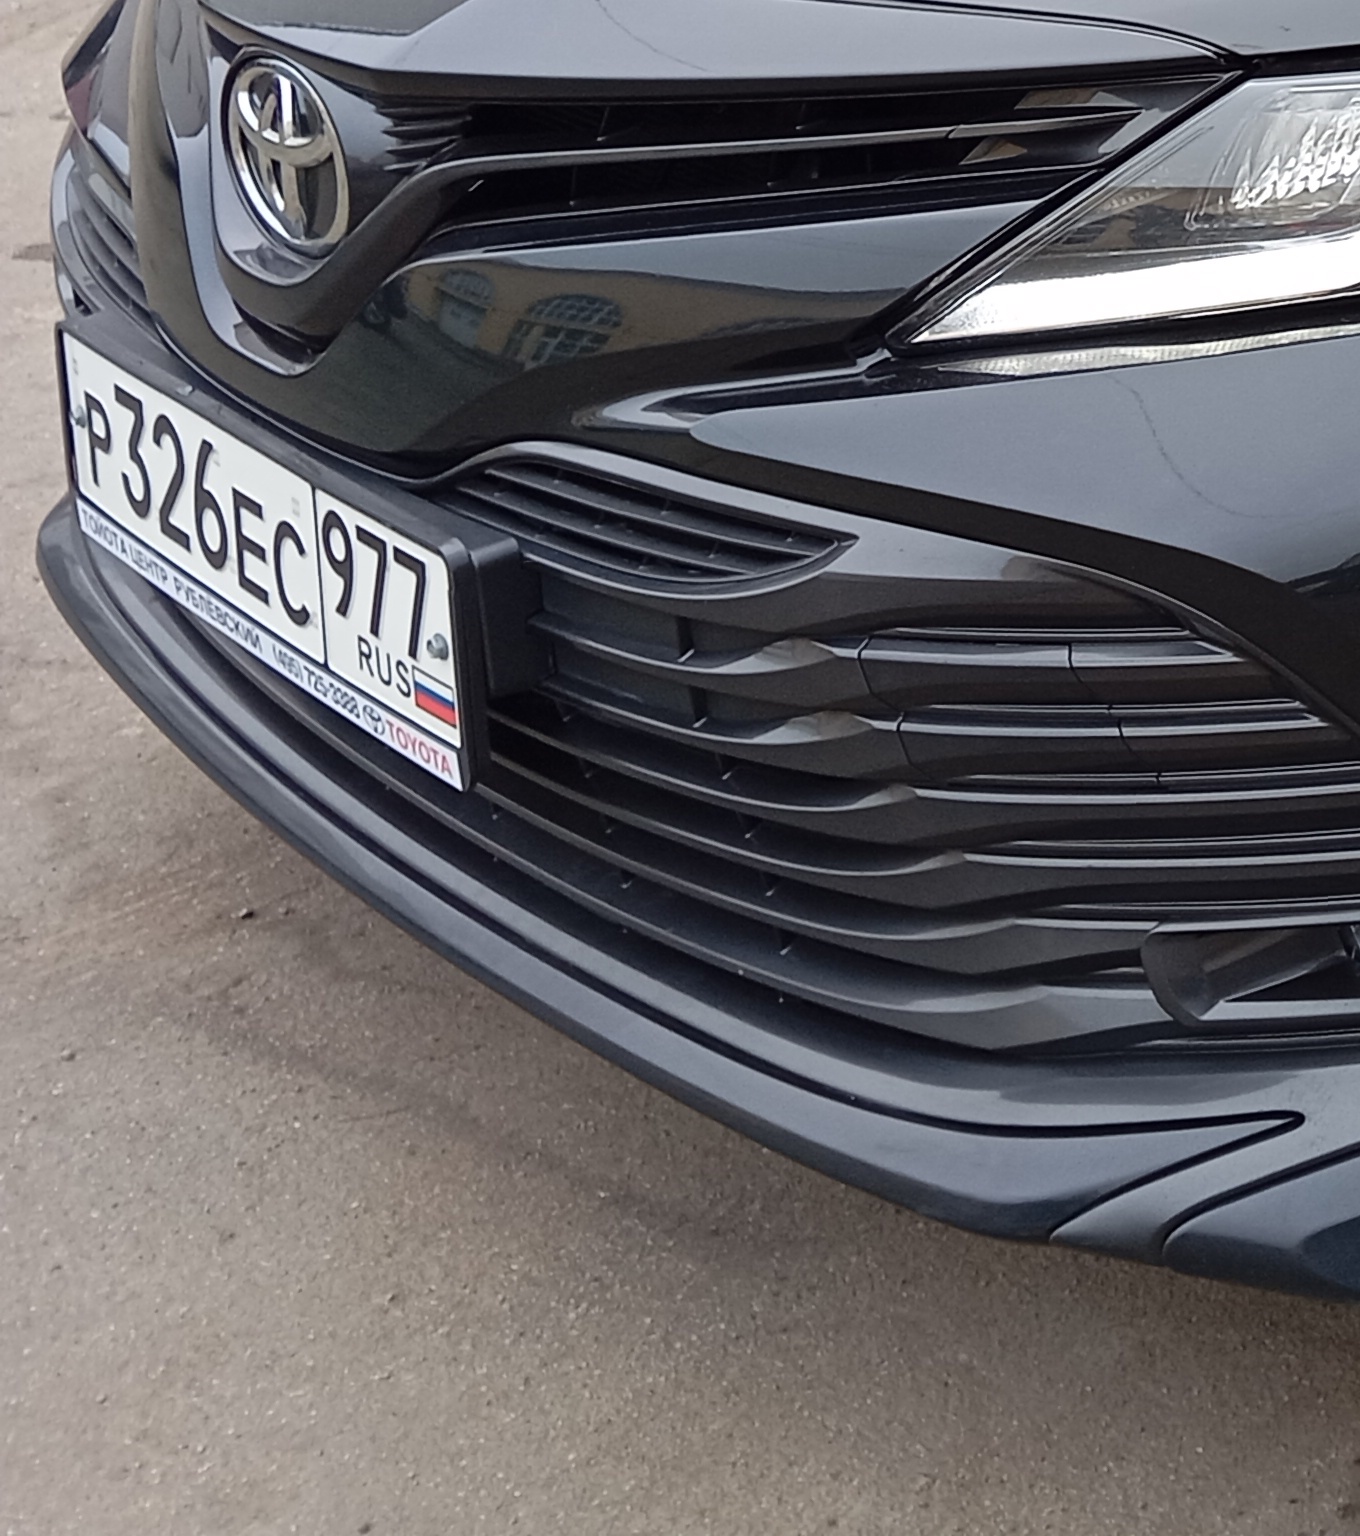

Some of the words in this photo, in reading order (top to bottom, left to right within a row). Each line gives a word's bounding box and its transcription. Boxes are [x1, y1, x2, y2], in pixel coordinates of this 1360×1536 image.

[322, 510, 426, 660] 977
[357, 634, 412, 699] RUS
[386, 719, 454, 780] TOYOTA
